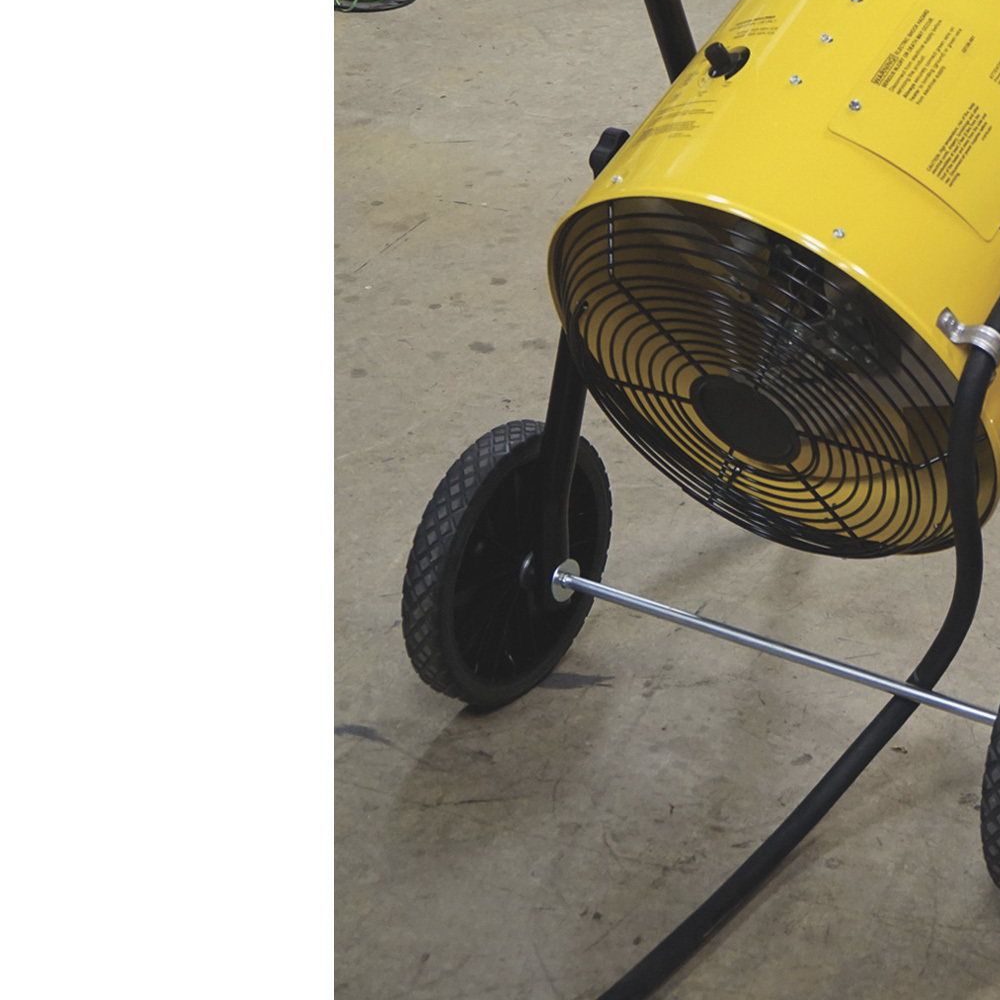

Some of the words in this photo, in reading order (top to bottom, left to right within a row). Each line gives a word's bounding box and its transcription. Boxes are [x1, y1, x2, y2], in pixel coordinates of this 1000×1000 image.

[873, 55, 895, 84] WARNING
[894, 35, 910, 55] ELECTRIC
[906, 23, 918, 37] SHOCK
[916, 8, 929, 25] HAZARD
